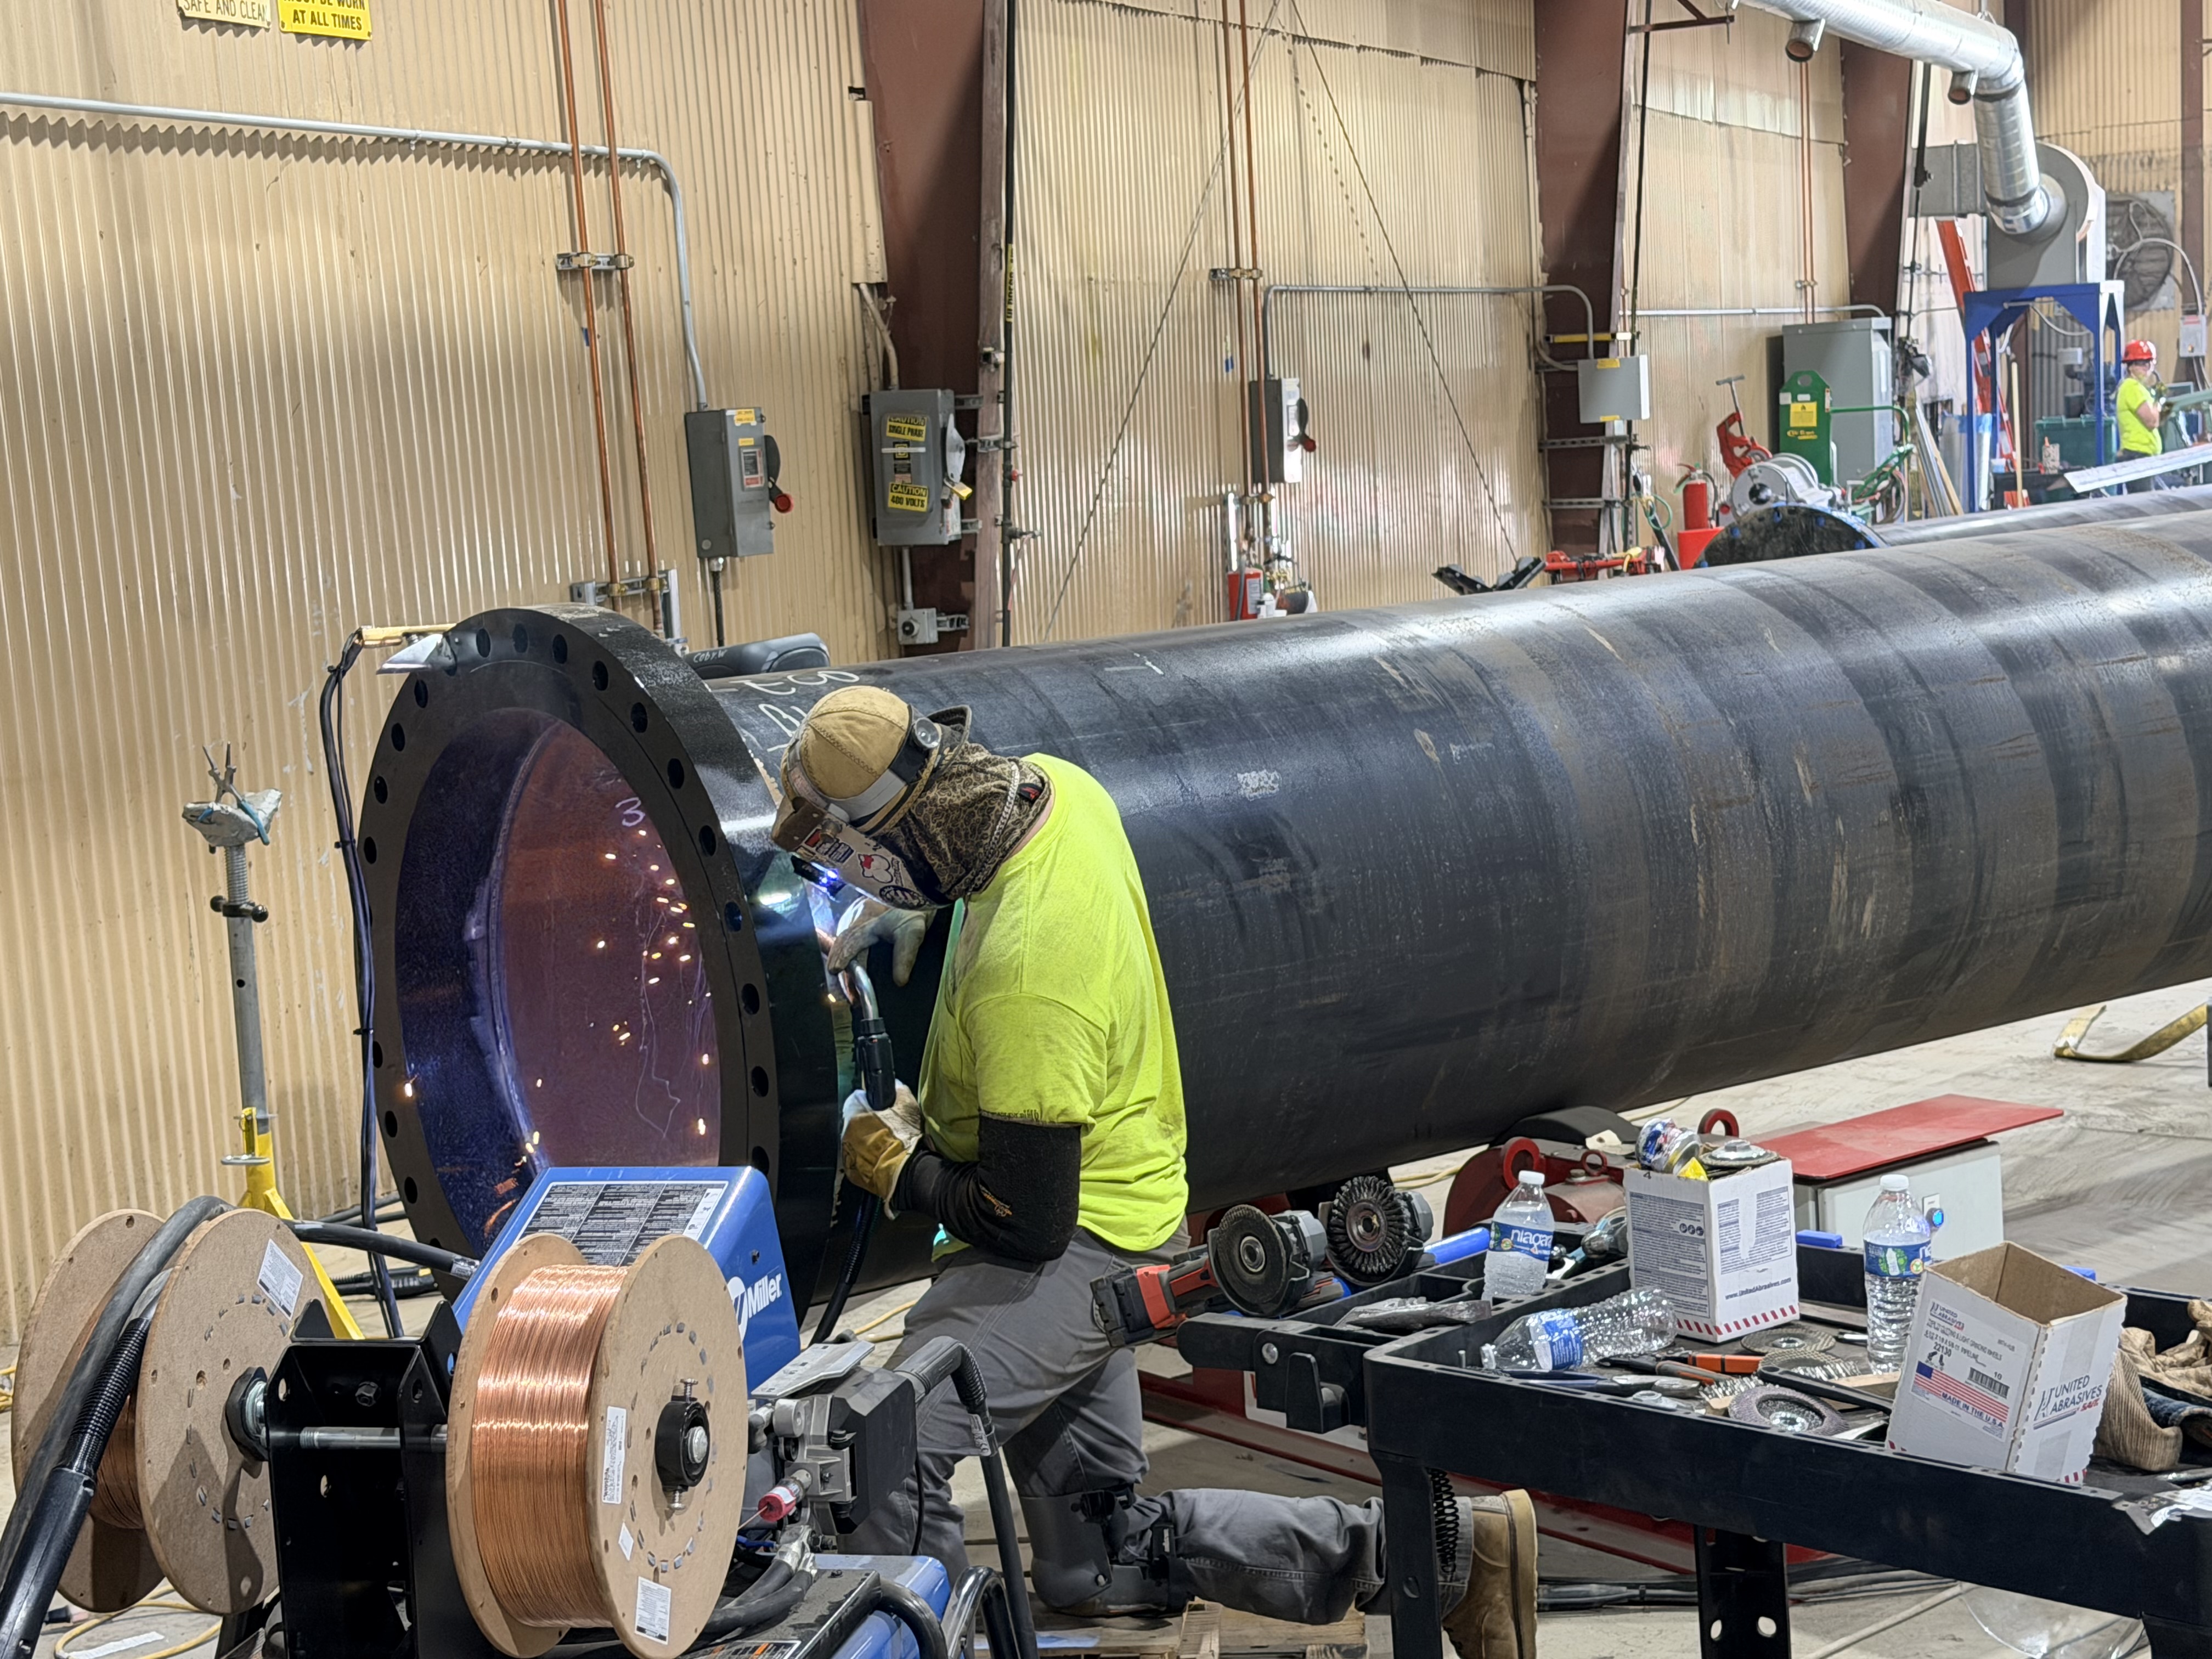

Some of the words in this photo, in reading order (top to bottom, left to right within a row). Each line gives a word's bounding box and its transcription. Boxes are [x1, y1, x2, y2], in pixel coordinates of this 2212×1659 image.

[184, 0, 211, 14] SAFE
[216, 0, 236, 17] AND
[292, 9, 306, 25] AT
[310, 10, 329, 27] ALL
[331, 13, 362, 31] TIMES
[889, 416, 926, 426] CAUTION
[888, 425, 905, 436] SINGLE
[907, 428, 924, 438] PHASE
[891, 484, 927, 497] CAUTION
[905, 497, 926, 509] VOLTS
[615, 797, 646, 827] 3
[1643, 1171, 1652, 1180] 4
[747, 1273, 782, 1319] Miller
[2055, 1375, 2090, 1398] UNITED
[1942, 1392, 1961, 1406] MADE
[1962, 1402, 1970, 1411] IN
[1971, 1407, 1984, 1417] THE
[2049, 1385, 2103, 1415] ABRASIVES
